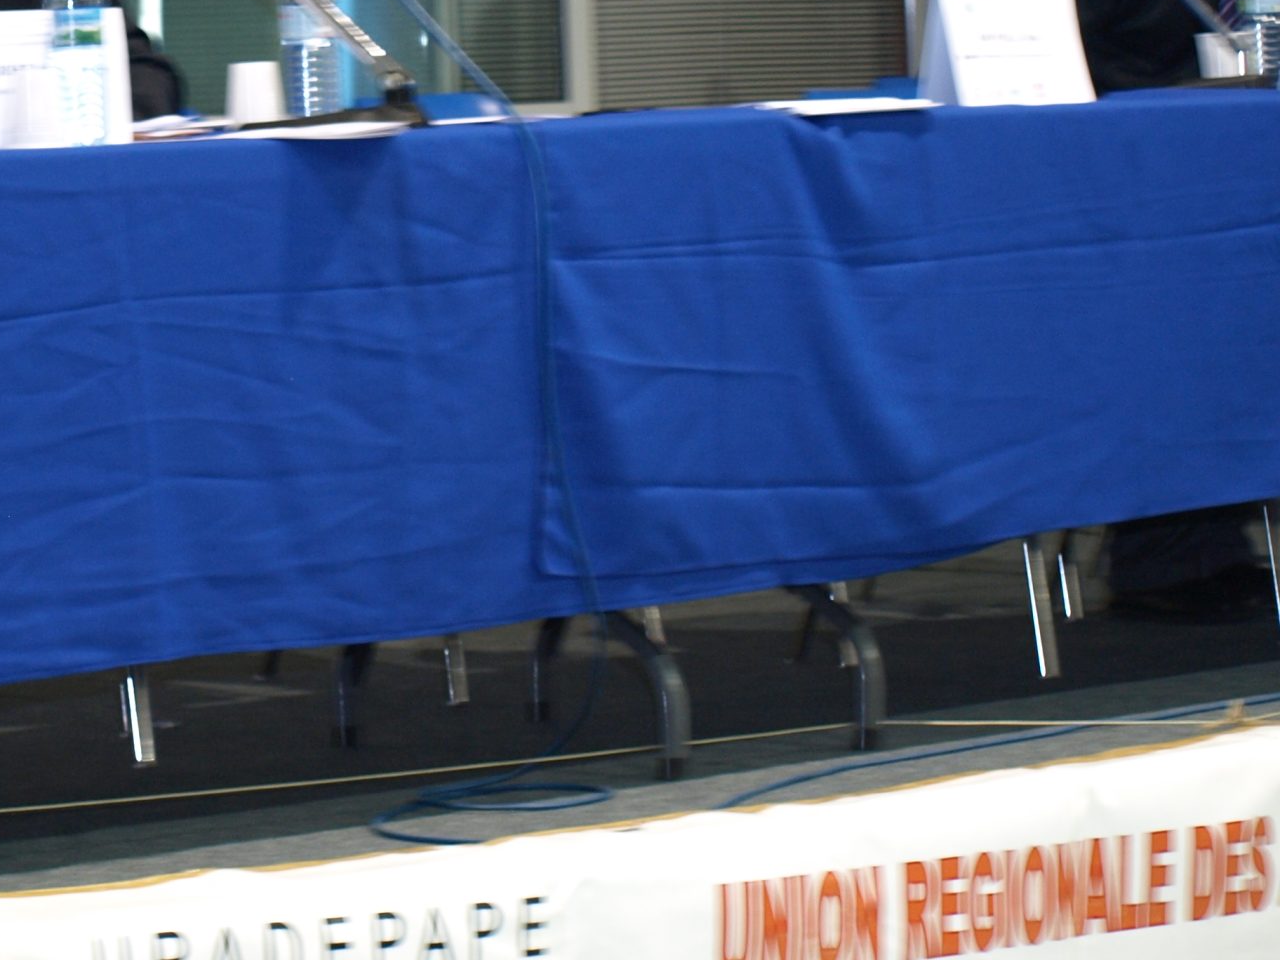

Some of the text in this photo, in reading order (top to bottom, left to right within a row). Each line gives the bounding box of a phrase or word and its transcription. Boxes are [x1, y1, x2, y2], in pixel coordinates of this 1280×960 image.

[715, 816, 1274, 960] UNION REGIONALE DES
